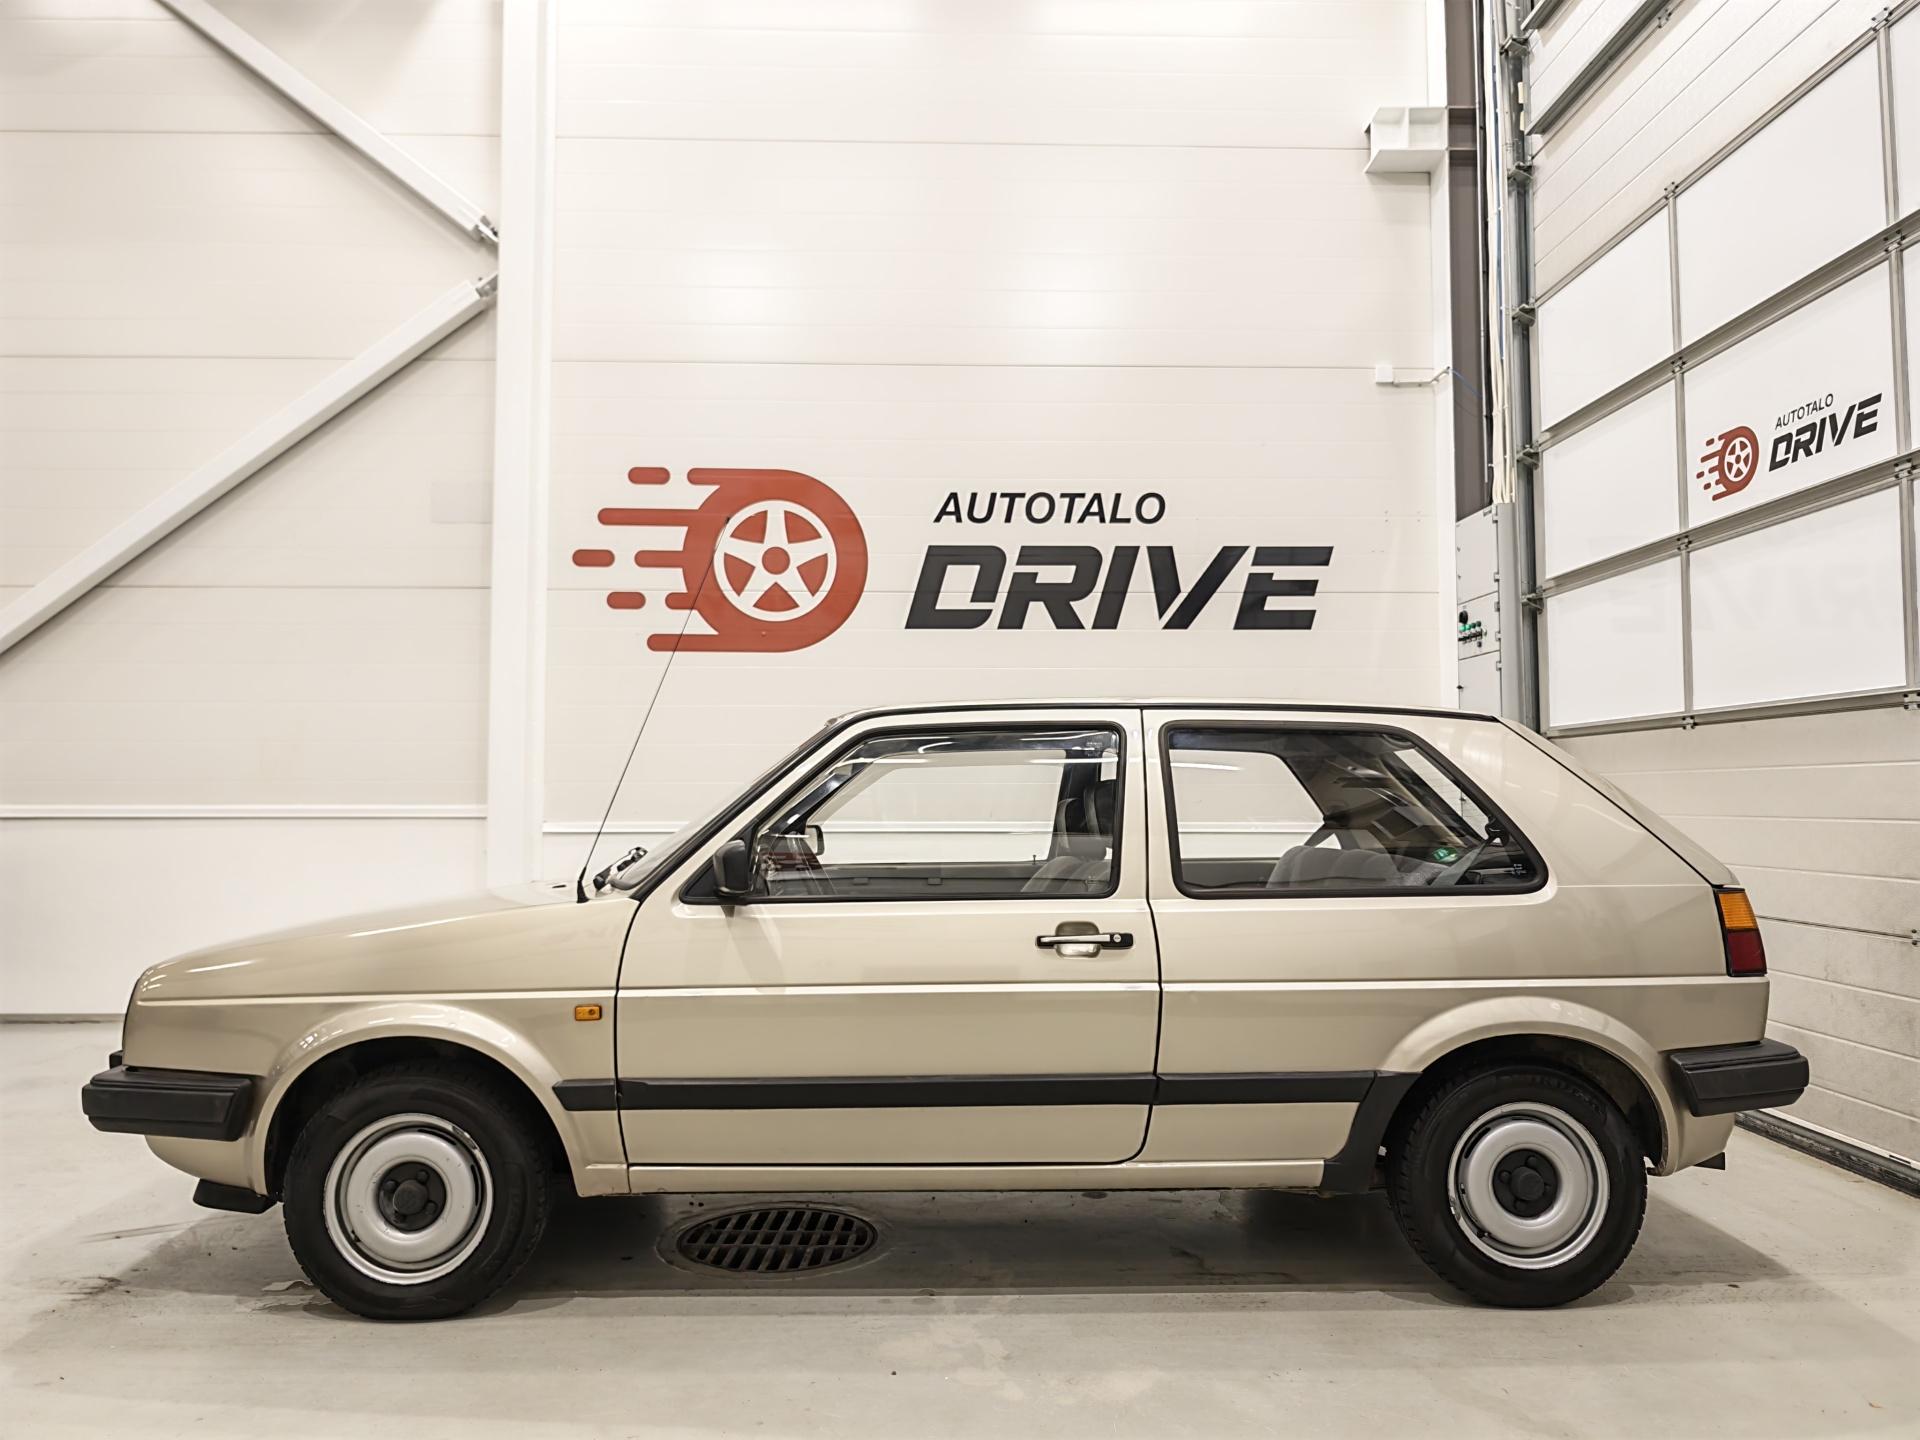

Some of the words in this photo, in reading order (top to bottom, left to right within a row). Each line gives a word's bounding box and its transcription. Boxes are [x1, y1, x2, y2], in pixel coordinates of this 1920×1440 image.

[1769, 393, 1882, 472] DRIVE
[1775, 393, 1834, 429] AUTOTALO
[933, 491, 1166, 525] AUTOTALO
[904, 545, 1334, 631] DRIVE
